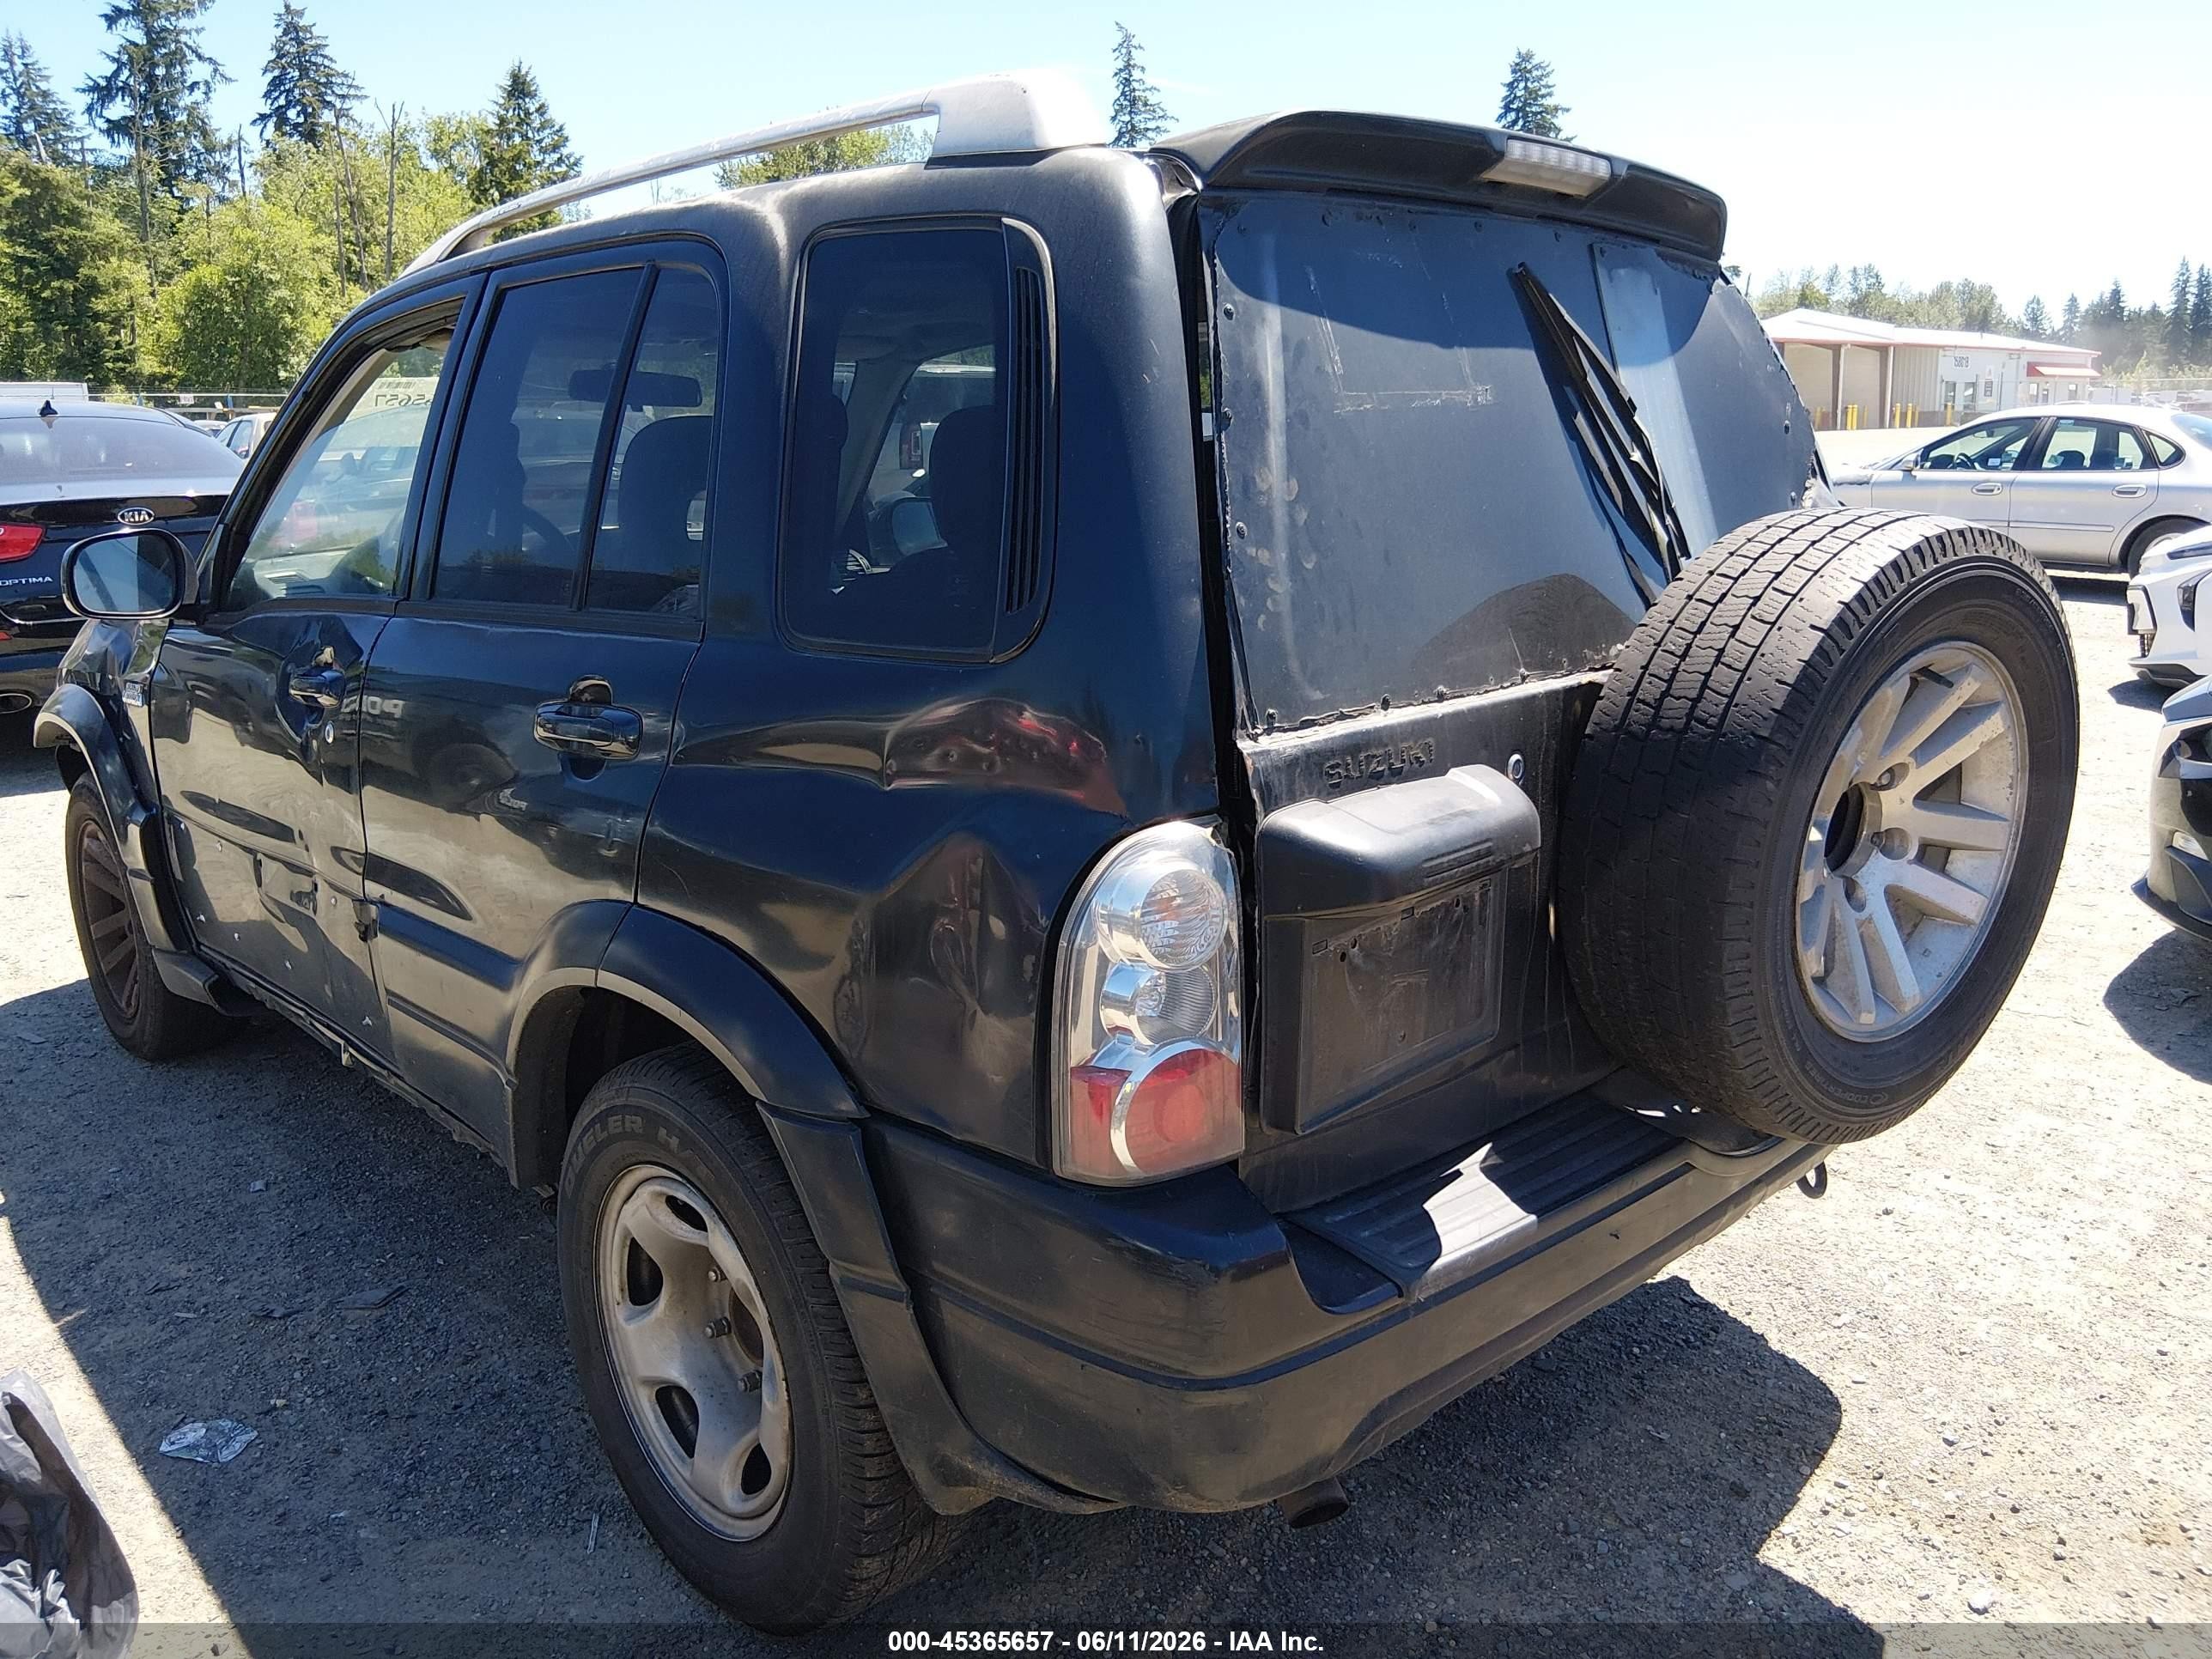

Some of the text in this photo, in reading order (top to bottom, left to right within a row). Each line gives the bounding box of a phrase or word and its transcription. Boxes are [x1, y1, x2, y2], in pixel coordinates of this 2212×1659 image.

[124, 510, 149, 522] KIA
[0, 576, 53, 586] OPTIMA
[1324, 739, 1435, 789] SUZUKI
[563, 1113, 646, 1200] DUELER
